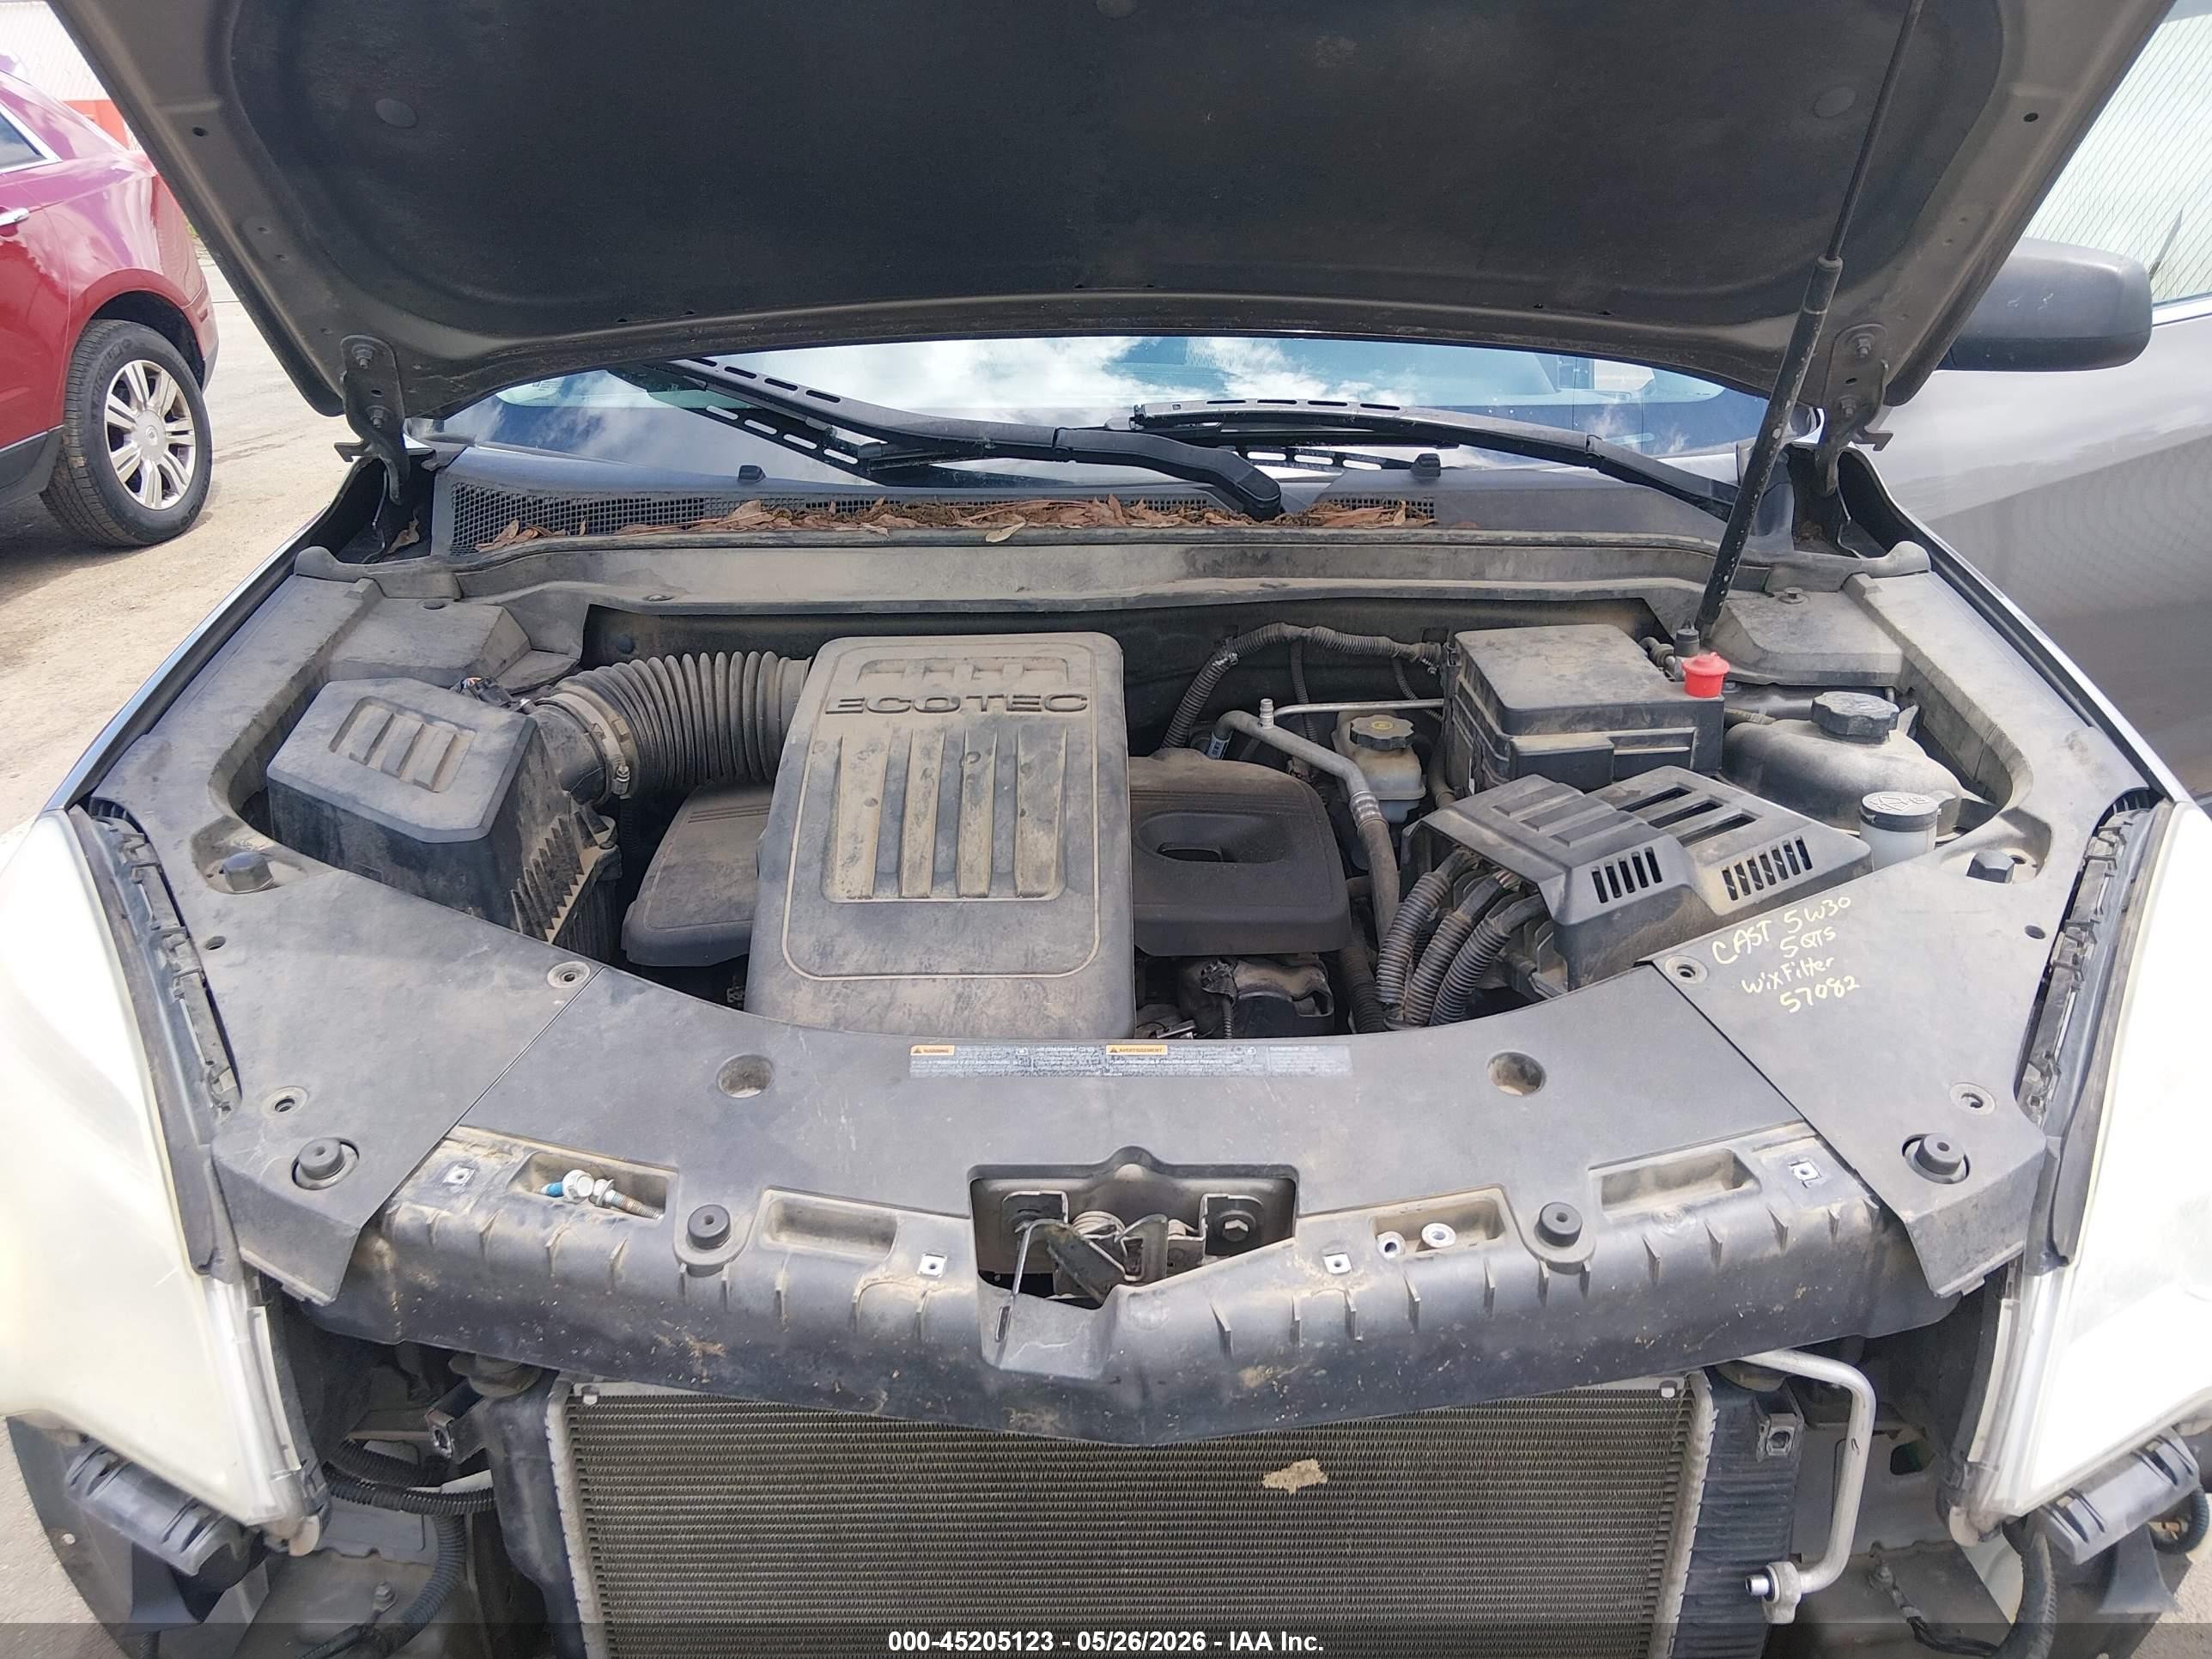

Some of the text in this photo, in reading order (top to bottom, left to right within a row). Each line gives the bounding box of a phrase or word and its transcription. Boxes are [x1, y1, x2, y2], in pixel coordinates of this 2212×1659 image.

[825, 693, 1088, 715] ECOTEC
[1711, 920, 1772, 964] CAST
[1779, 975, 1860, 1013] 57082
